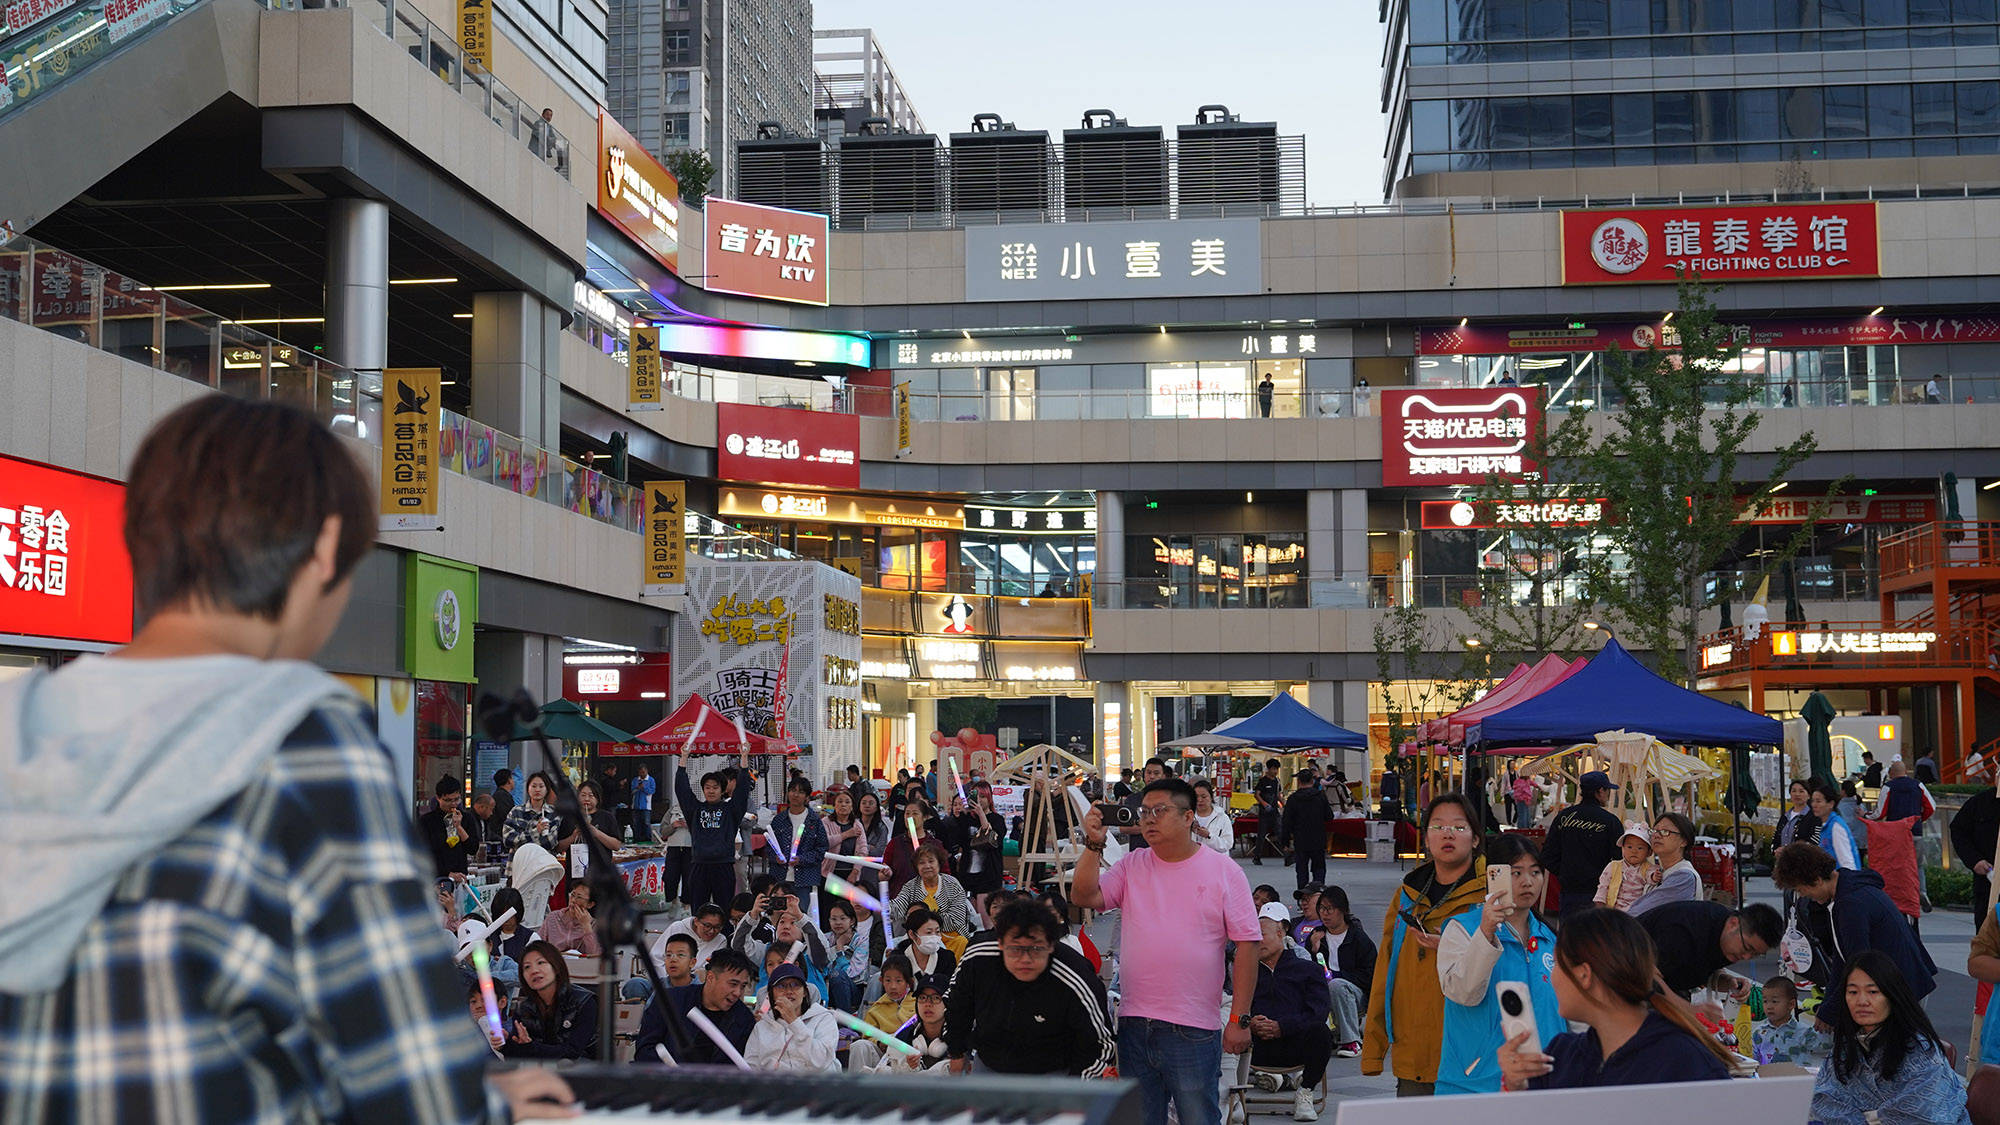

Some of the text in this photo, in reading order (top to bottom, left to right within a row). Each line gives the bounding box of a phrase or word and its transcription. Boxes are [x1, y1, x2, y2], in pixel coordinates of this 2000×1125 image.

[719, 223, 815, 263] 音为欢
[1664, 215, 1849, 256] 龍泰拳馆
[1060, 239, 1226, 280] 小壹美
[1691, 255, 1822, 271] FIGHTING CLUB
[781, 264, 815, 282] KTV
[1241, 334, 1316, 354] 小壹美
[279, 350, 292, 359] 2F
[392, 487, 427, 495] Himaxx
[20, 505, 70, 554] 零食
[18, 551, 68, 596] 乐园
[1800, 632, 1880, 653] 野人先生
[724, 671, 778, 691] 骑士
